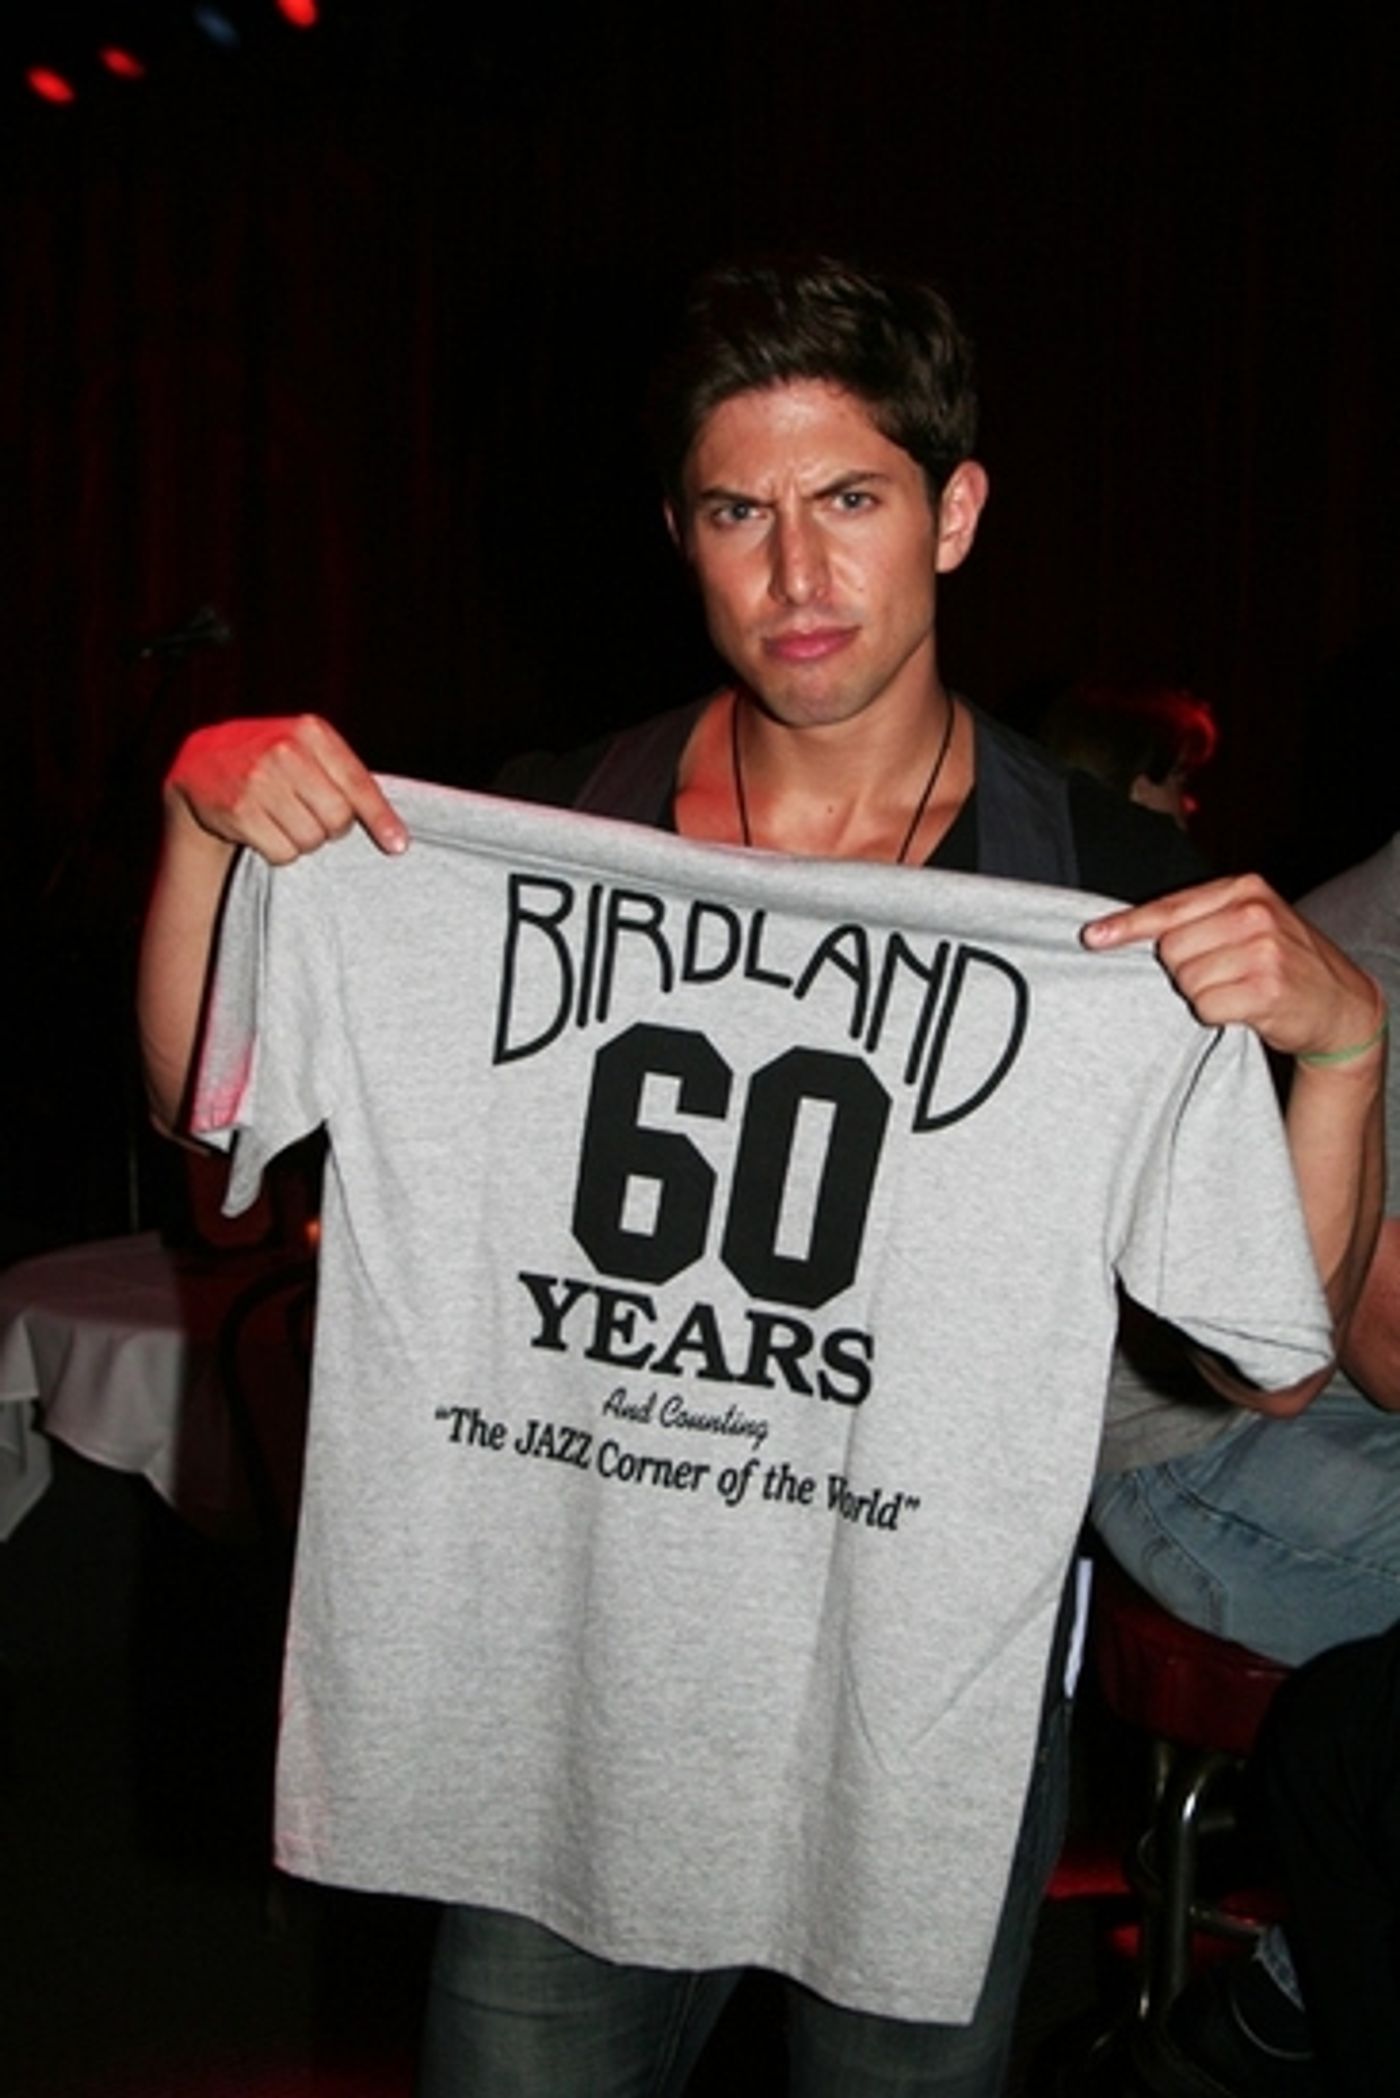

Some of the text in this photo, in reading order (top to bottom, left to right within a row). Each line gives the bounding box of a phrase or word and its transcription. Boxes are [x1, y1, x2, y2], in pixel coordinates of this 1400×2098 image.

[492, 873, 1029, 1133] BIRDLAND
[571, 1022, 893, 1311] 60
[517, 1270, 875, 1408] YEARS
[513, 1419, 592, 1471] JAZZ
[597, 1439, 710, 1491] Corner
[716, 1457, 760, 1507] of
[761, 1463, 817, 1506] the
[602, 1387, 770, 1450] And Counting
